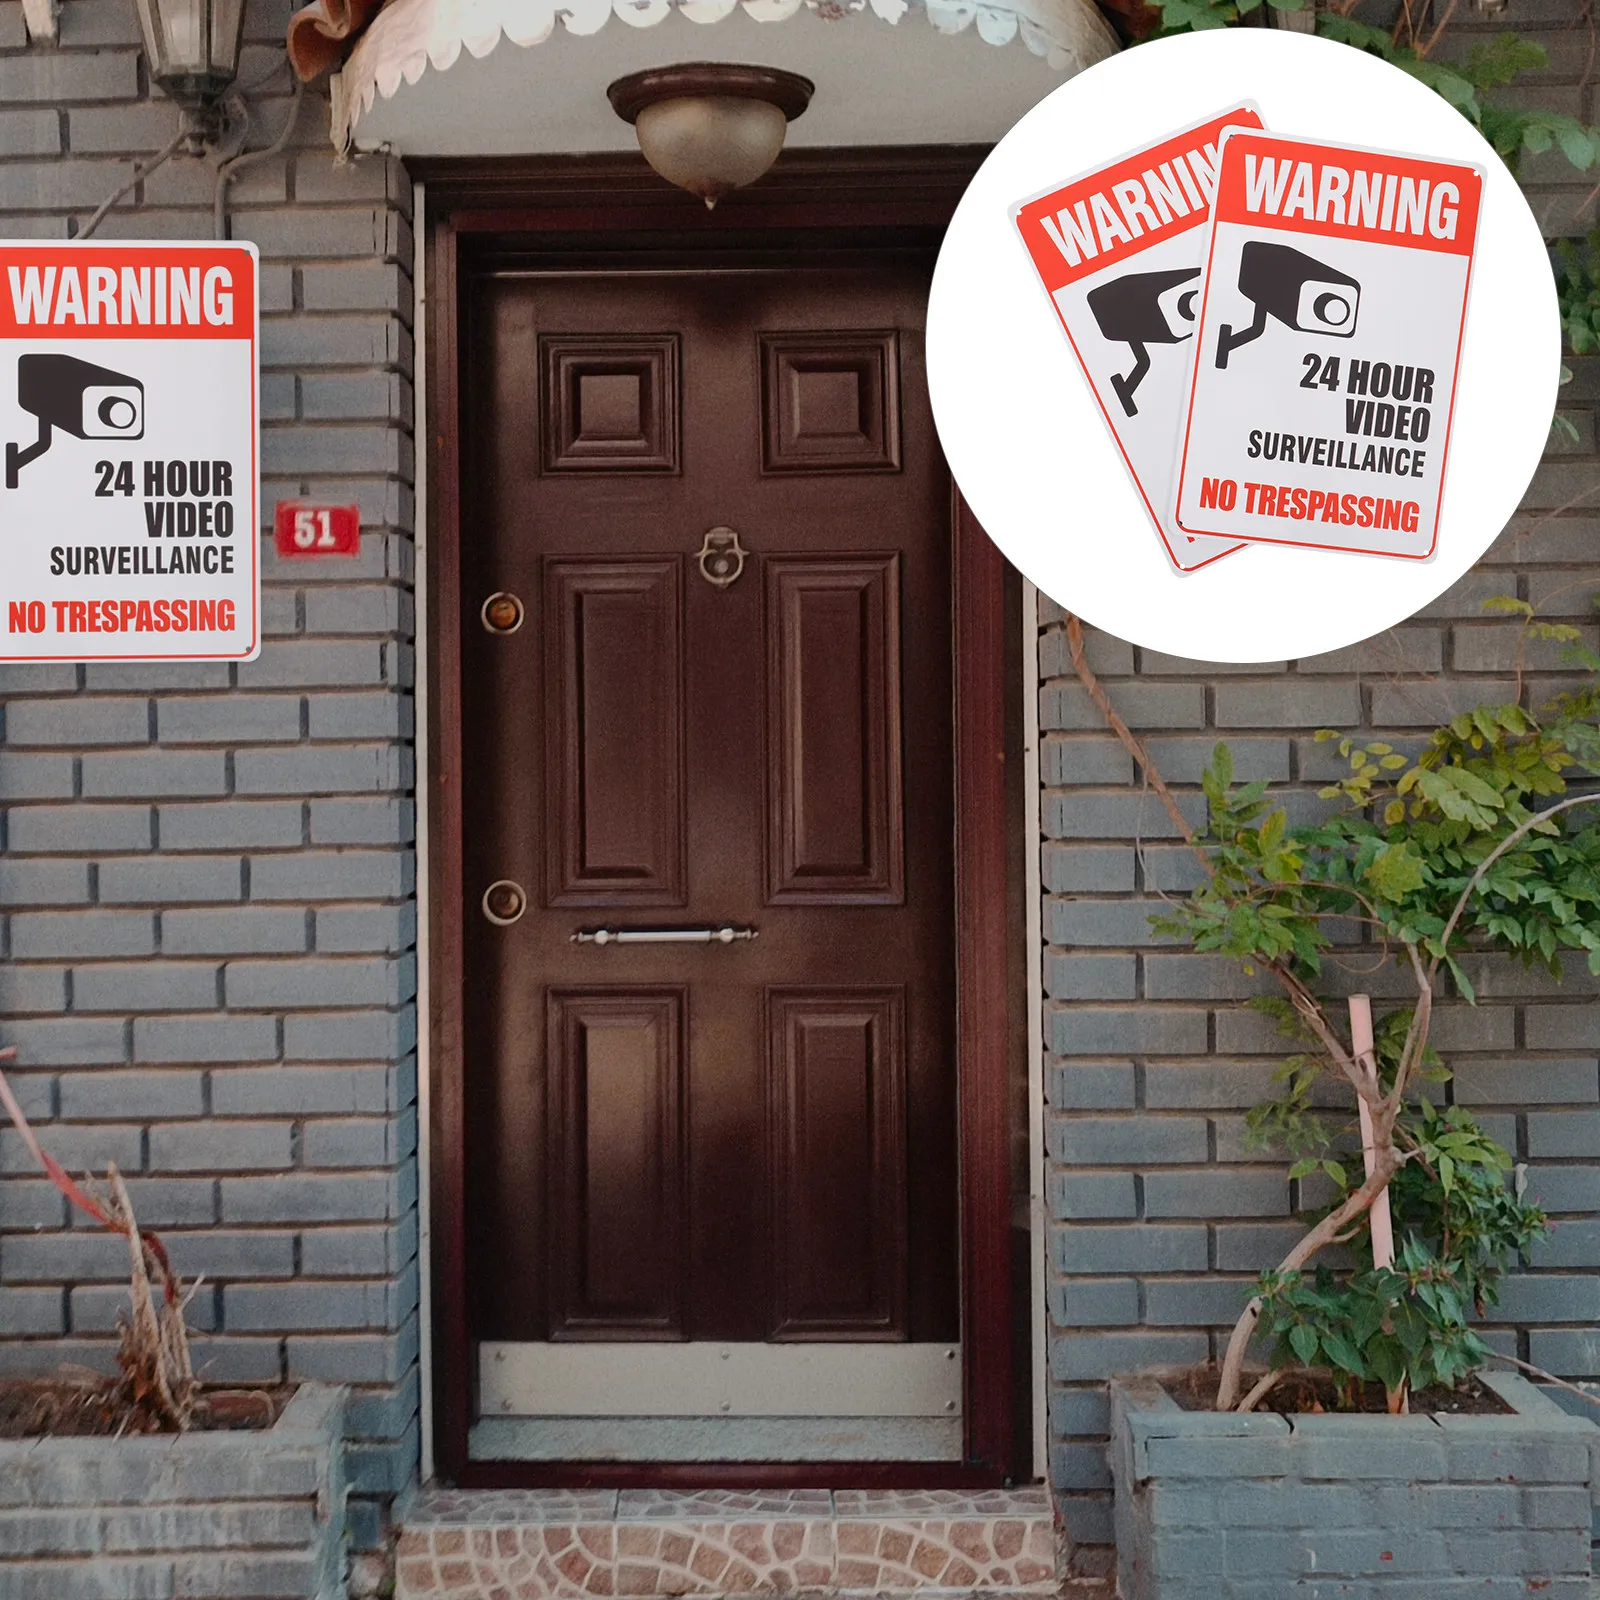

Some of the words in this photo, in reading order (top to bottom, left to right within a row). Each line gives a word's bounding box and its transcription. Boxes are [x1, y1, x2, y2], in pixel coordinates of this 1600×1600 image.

[1039, 142, 1217, 268] WARNIN
[1244, 154, 1460, 240] WARNING
[8, 266, 234, 326] WARNING
[1300, 353, 1340, 392] 24
[1346, 360, 1435, 404] HOUR
[1345, 398, 1431, 443] VIDEO
[1247, 430, 1426, 478] SURVEILLANCE
[95, 460, 135, 497] 24
[144, 460, 233, 497] HOUR
[145, 501, 234, 538] VIDEO
[1199, 477, 1237, 511] NO
[1243, 483, 1420, 533] TRESPASSING
[293, 510, 336, 548] 51
[50, 545, 234, 575] SURVEILLANCE
[8, 601, 46, 633] NO
[52, 600, 236, 633] TRESPASSING
